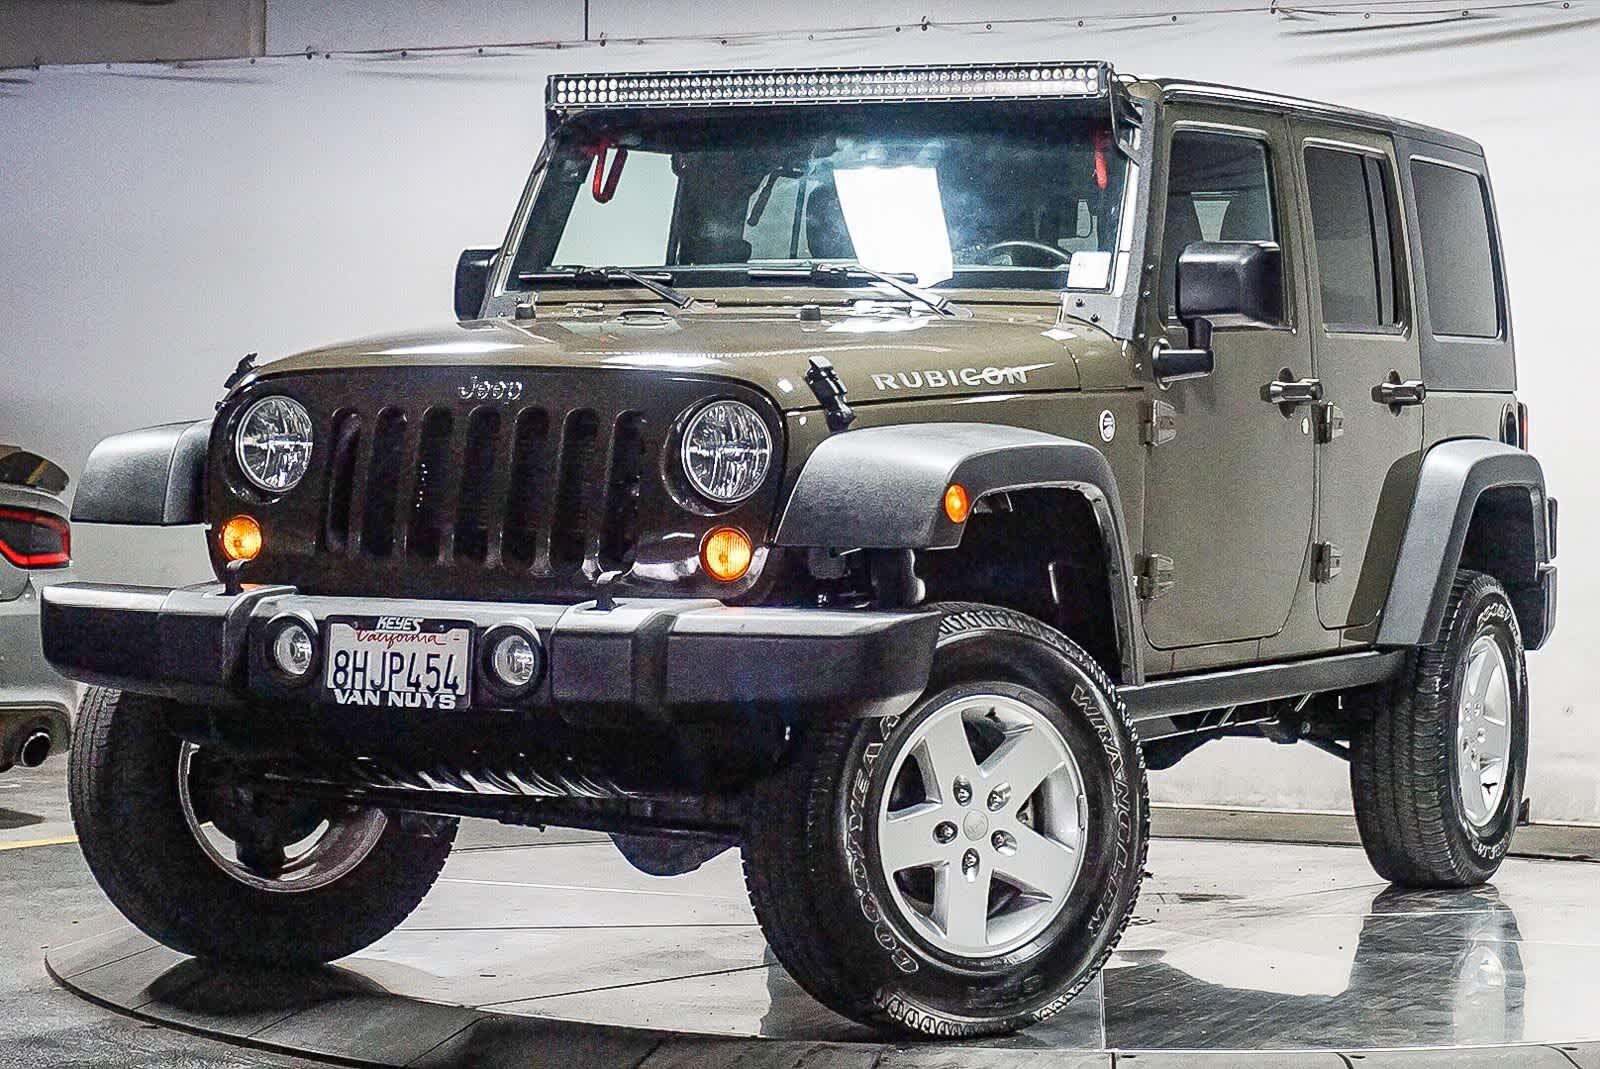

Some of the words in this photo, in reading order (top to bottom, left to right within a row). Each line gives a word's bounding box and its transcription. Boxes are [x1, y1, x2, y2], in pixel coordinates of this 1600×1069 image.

[458, 375, 523, 405] Jeep
[870, 366, 1027, 391] RUBICON
[376, 616, 424, 633] KEYES
[356, 628, 447, 649] California
[333, 650, 460, 695] 8HJP454
[334, 688, 380, 706] VAN
[388, 691, 456, 710] NUYS
[1071, 683, 1131, 938] WRANGLER
